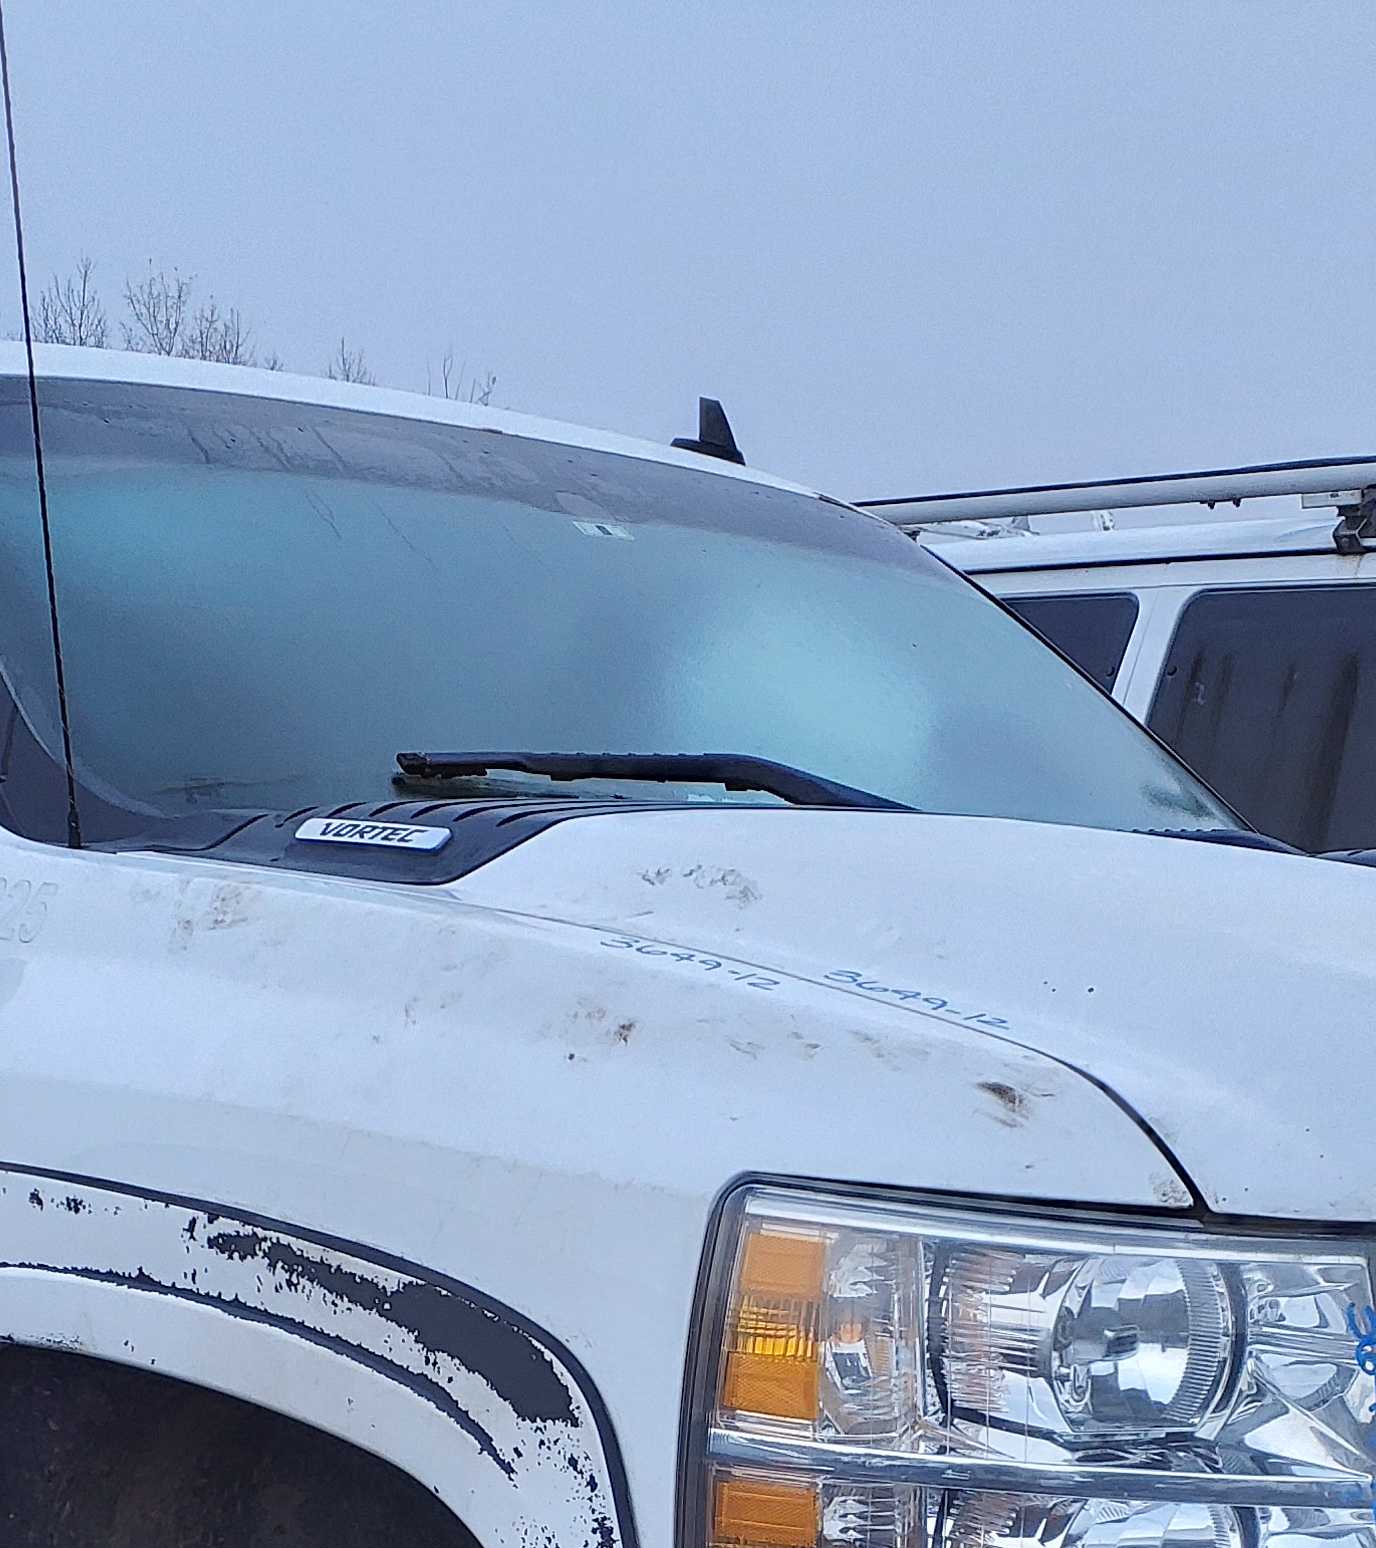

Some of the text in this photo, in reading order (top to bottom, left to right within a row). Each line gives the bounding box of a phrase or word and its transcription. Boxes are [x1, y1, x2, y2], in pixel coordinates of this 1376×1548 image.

[318, 821, 427, 844] VORTEC
[599, 937, 782, 992] 3649-12
[823, 969, 1011, 1031] 3649-12
